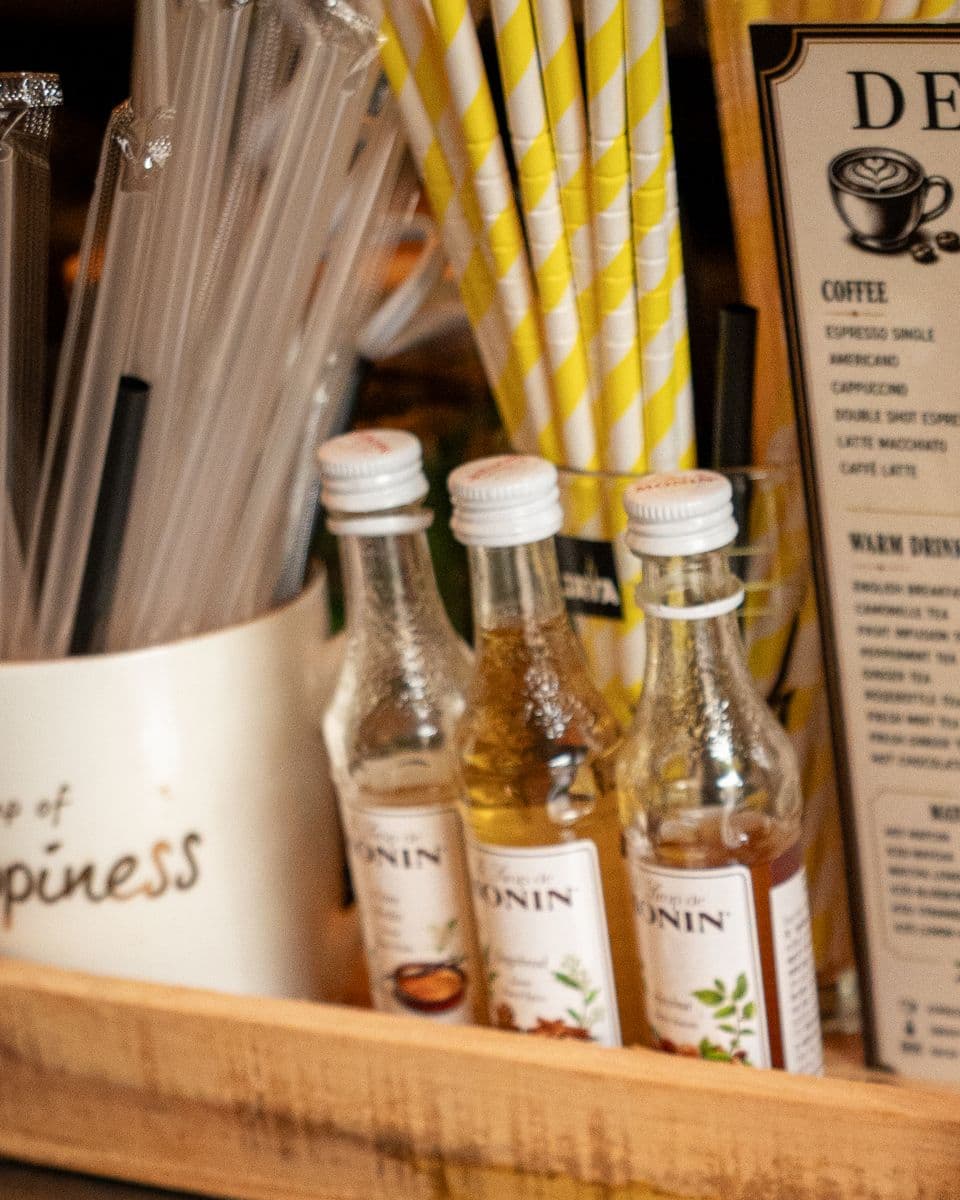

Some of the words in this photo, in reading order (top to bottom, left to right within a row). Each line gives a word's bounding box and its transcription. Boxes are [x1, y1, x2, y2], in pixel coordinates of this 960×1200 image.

[821, 279, 888, 304] COFFEE
[849, 532, 903, 556] WARM
[0, 832, 202, 930] piness
[476, 881, 573, 912] ONIN
[638, 900, 725, 934] ONIN
